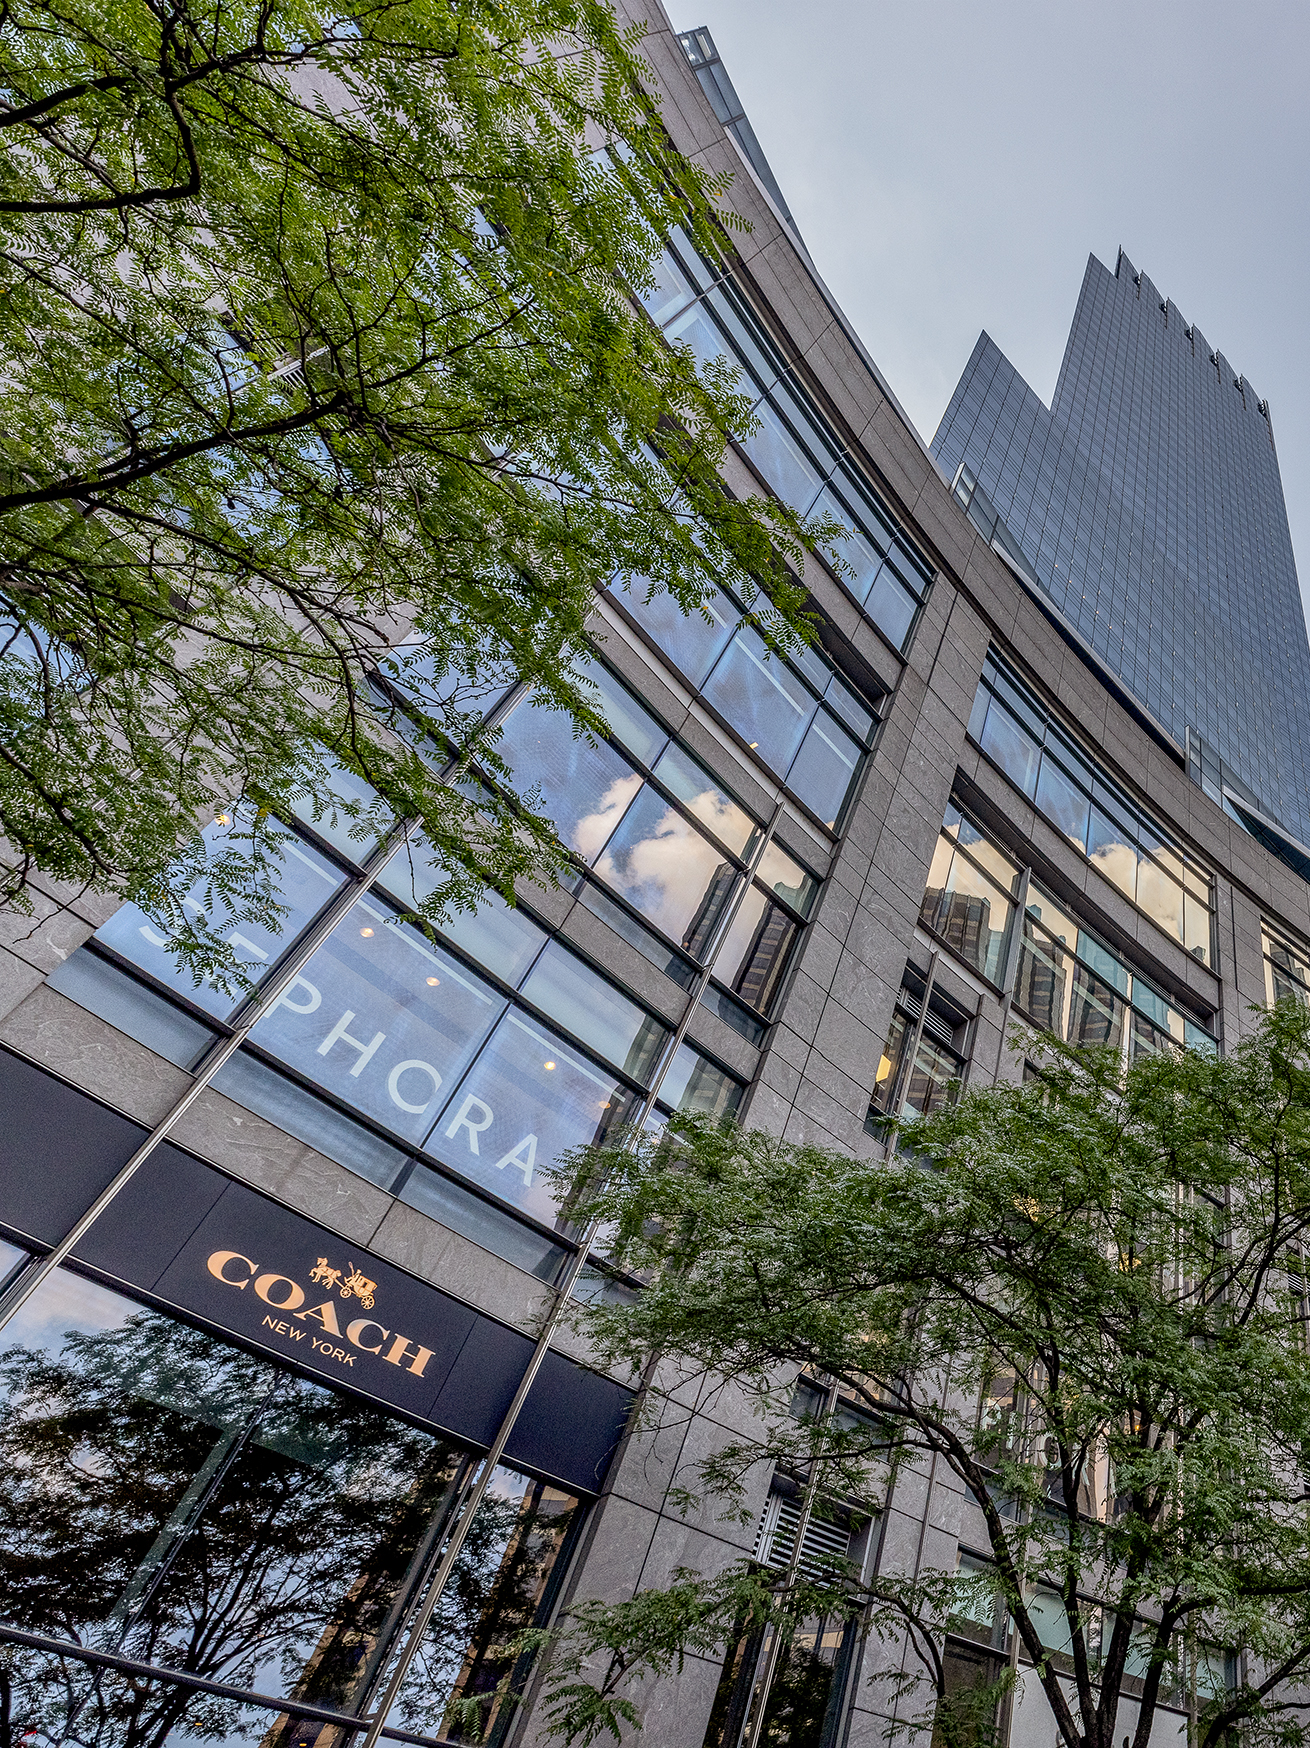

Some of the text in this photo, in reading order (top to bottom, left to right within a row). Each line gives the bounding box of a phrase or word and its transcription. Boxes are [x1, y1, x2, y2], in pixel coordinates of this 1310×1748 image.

[207, 1250, 436, 1377] COACH
[261, 1315, 358, 1366] NEW YORK
